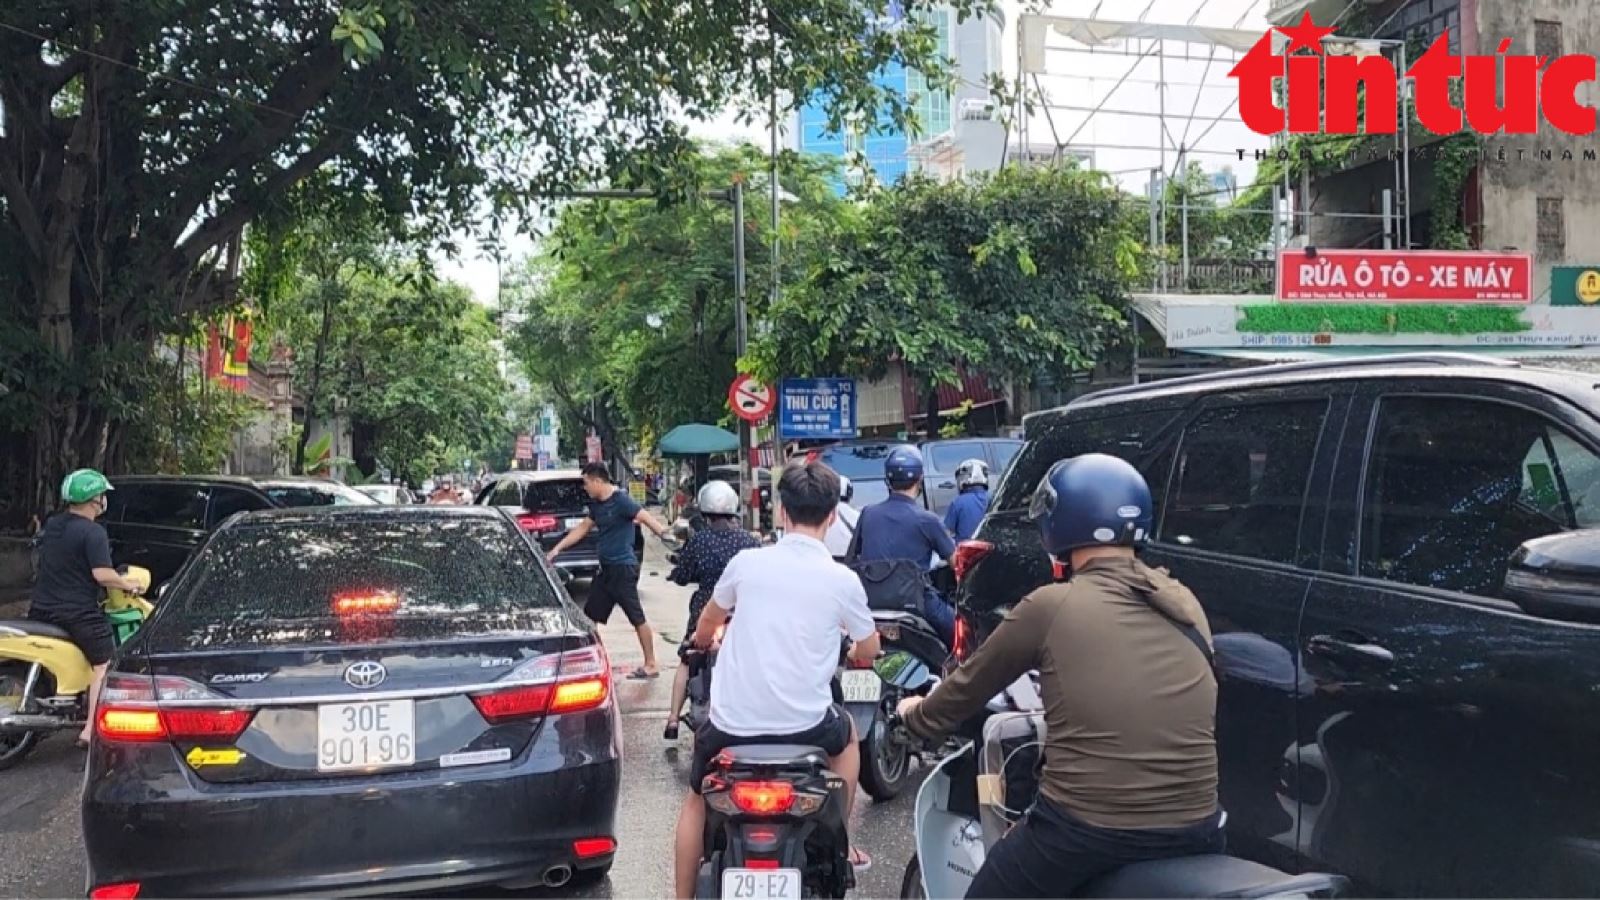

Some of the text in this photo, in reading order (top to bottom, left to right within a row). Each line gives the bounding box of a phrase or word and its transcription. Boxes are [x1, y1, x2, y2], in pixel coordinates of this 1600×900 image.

[1299, 257, 1348, 287] RỬA
[1354, 259, 1374, 288] Ô
[1379, 259, 1411, 288] TÔ
[1429, 265, 1459, 288] XE
[1464, 260, 1514, 288] MÁY
[786, 395, 809, 411] THU
[342, 703, 391, 733] 30E
[734, 874, 790, 899] 29-E2
